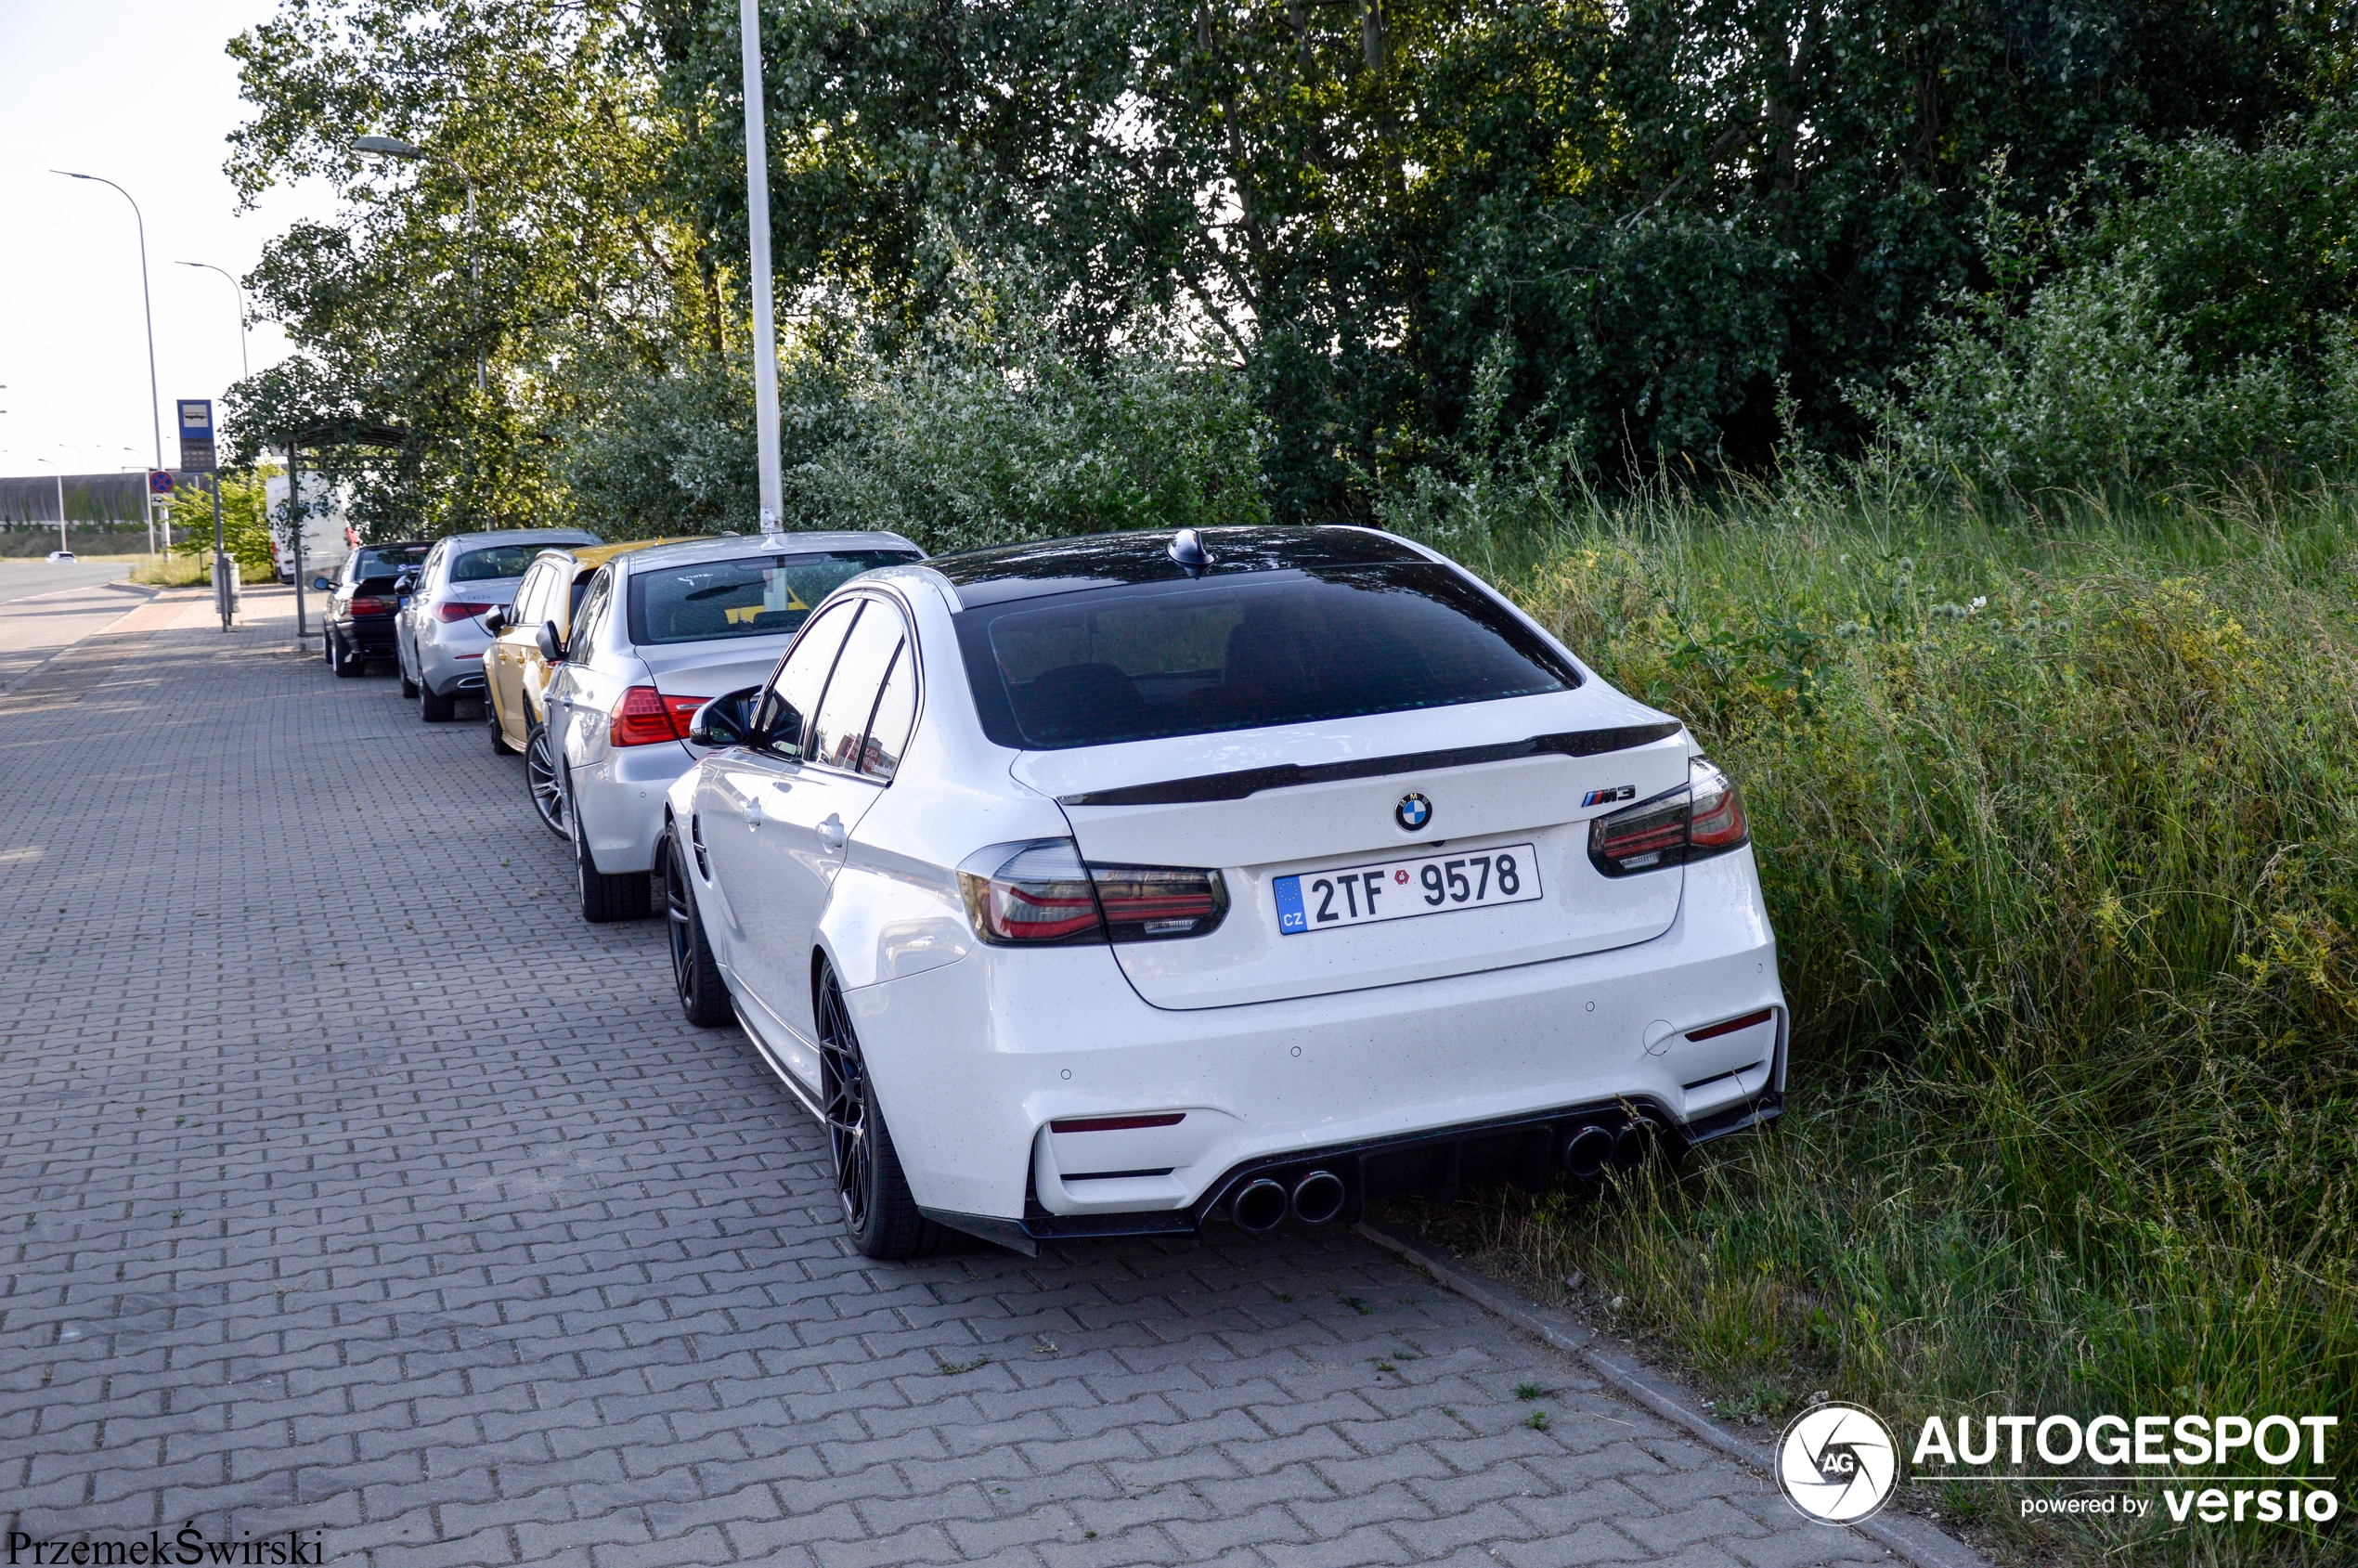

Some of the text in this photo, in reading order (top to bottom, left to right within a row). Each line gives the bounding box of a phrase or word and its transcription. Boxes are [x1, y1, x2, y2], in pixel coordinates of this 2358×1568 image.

[1399, 793, 1430, 808] BMW
[1590, 784, 1636, 806] M3
[1312, 854, 1521, 923] 2TF 9578
[1283, 913, 1303, 927] CZ
